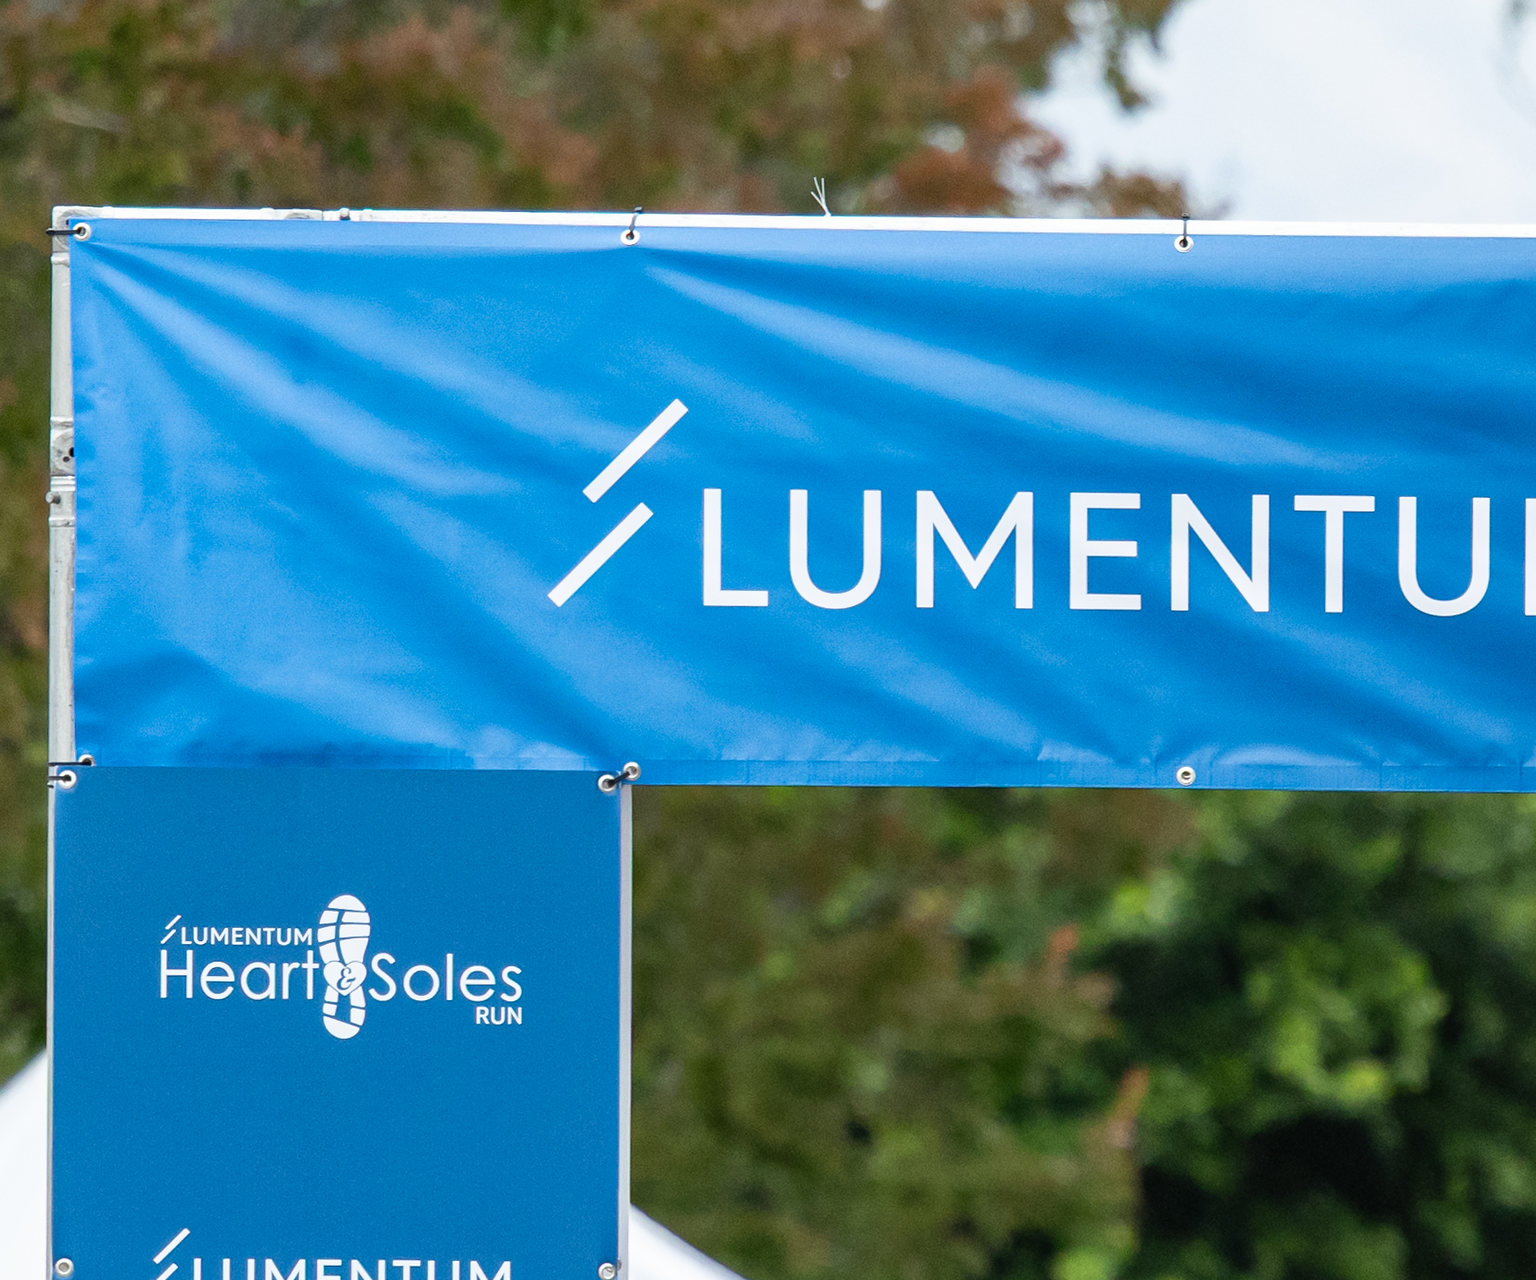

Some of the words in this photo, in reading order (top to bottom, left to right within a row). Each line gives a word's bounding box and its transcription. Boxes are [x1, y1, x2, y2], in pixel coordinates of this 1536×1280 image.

[183, 928, 313, 946] LUMENTUM
[162, 951, 319, 1000] Heart
[370, 954, 522, 1002] Soles
[477, 1008, 522, 1025] RUN
